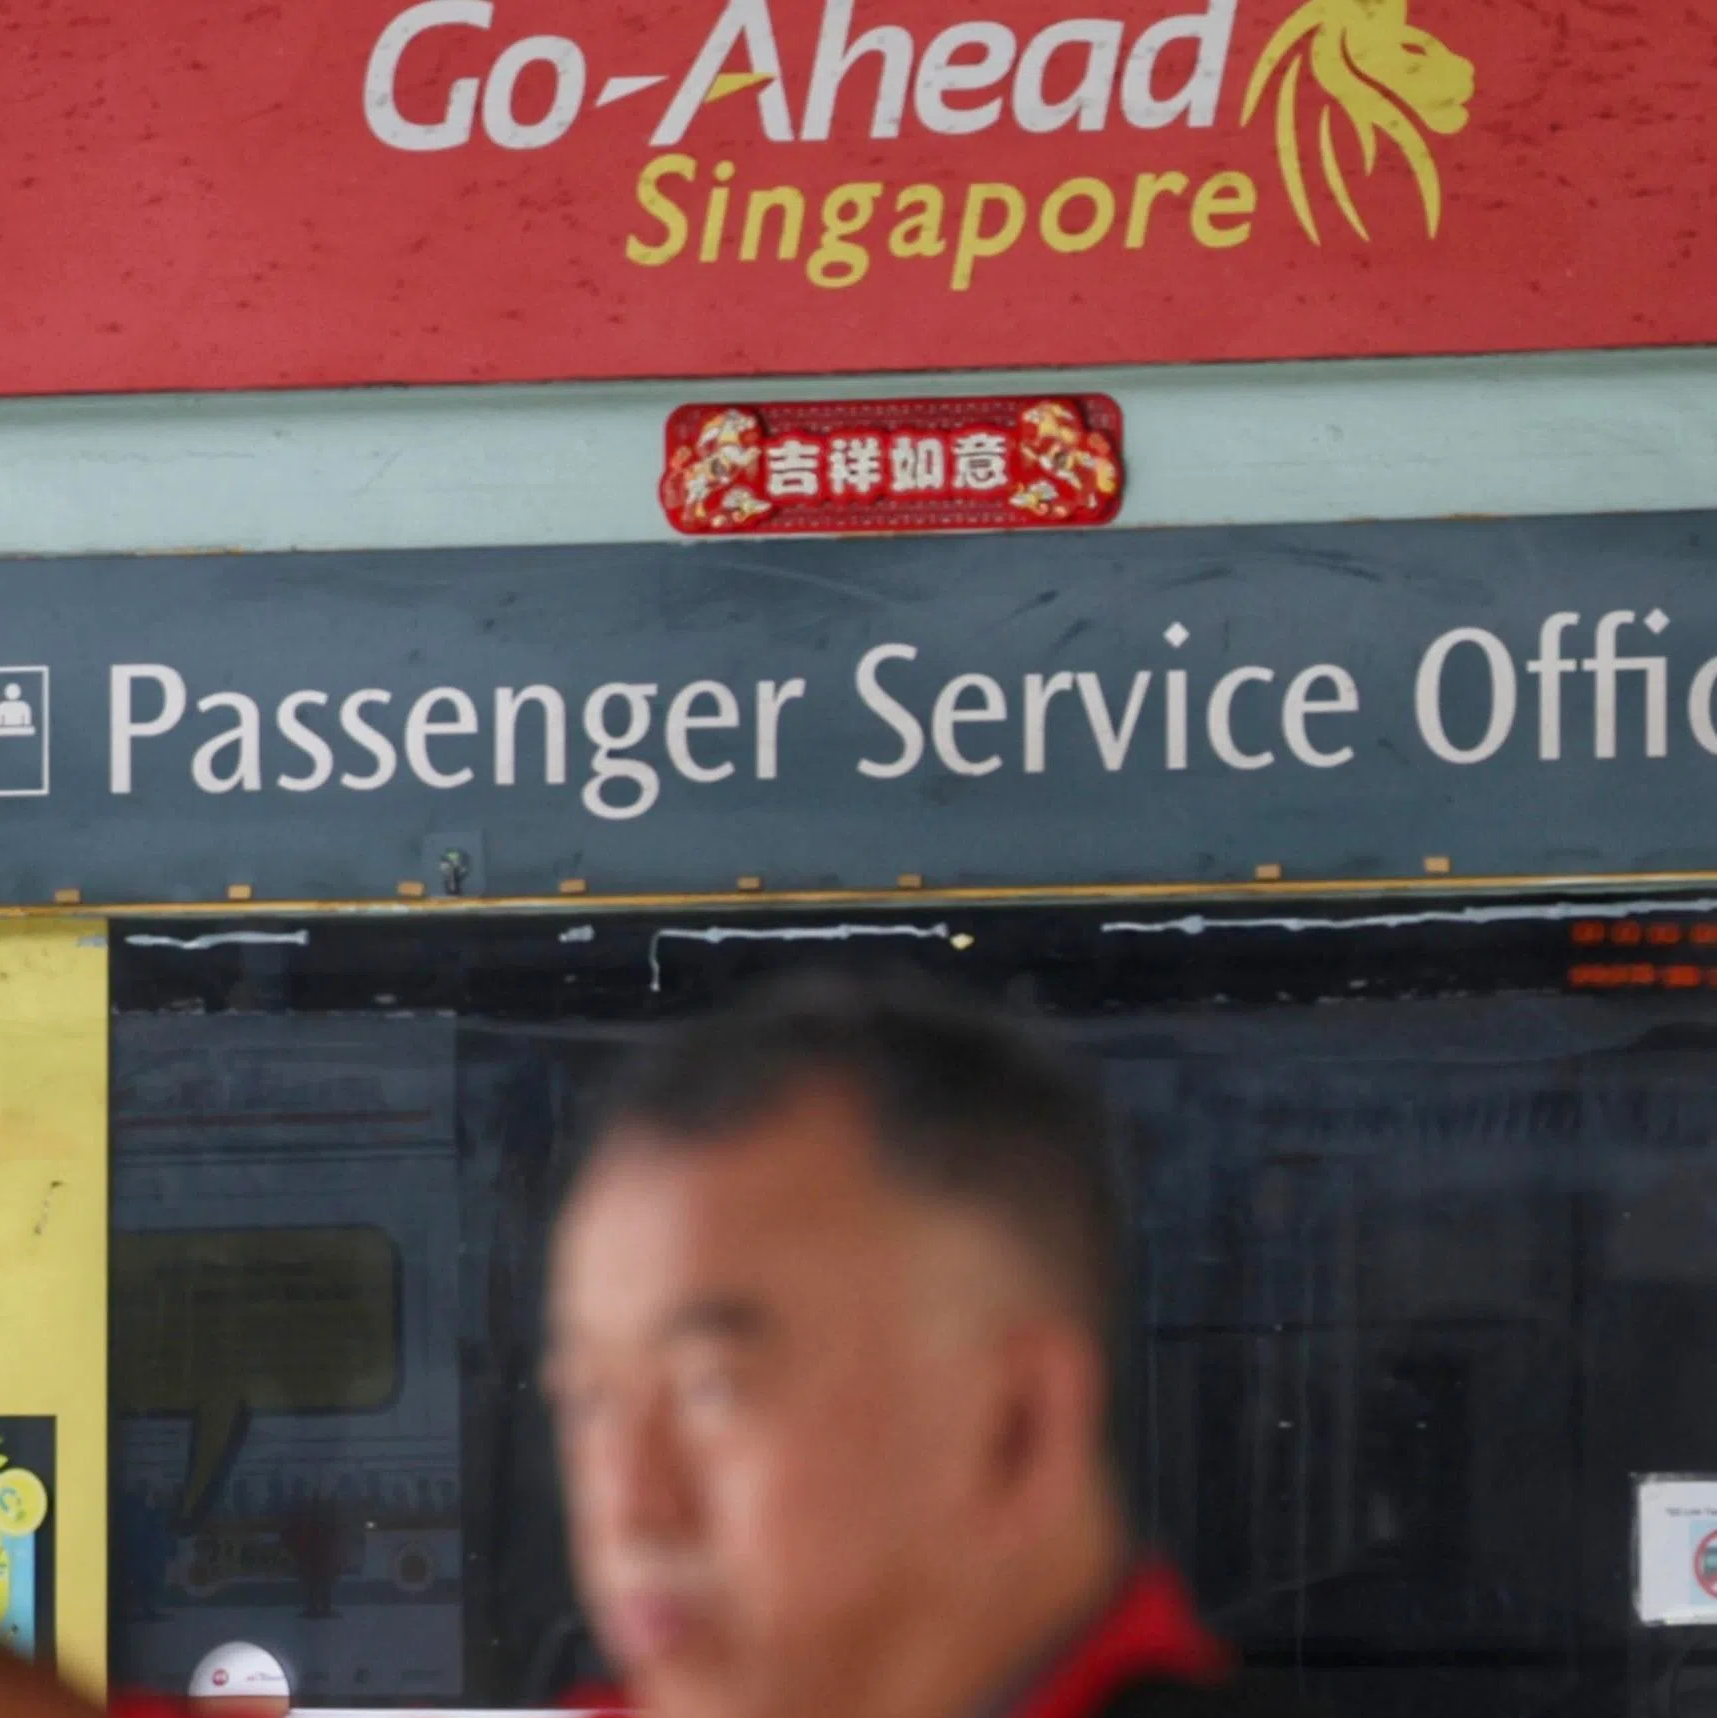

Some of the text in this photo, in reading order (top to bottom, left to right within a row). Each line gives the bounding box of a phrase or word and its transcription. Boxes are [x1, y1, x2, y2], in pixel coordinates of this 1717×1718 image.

[364, 0, 1238, 151] Go-Ahead
[625, 154, 1257, 291] Singapore
[768, 433, 1008, 497] 吉祥如意
[109, 662, 806, 820] Passenger
[855, 621, 1360, 779] Service
